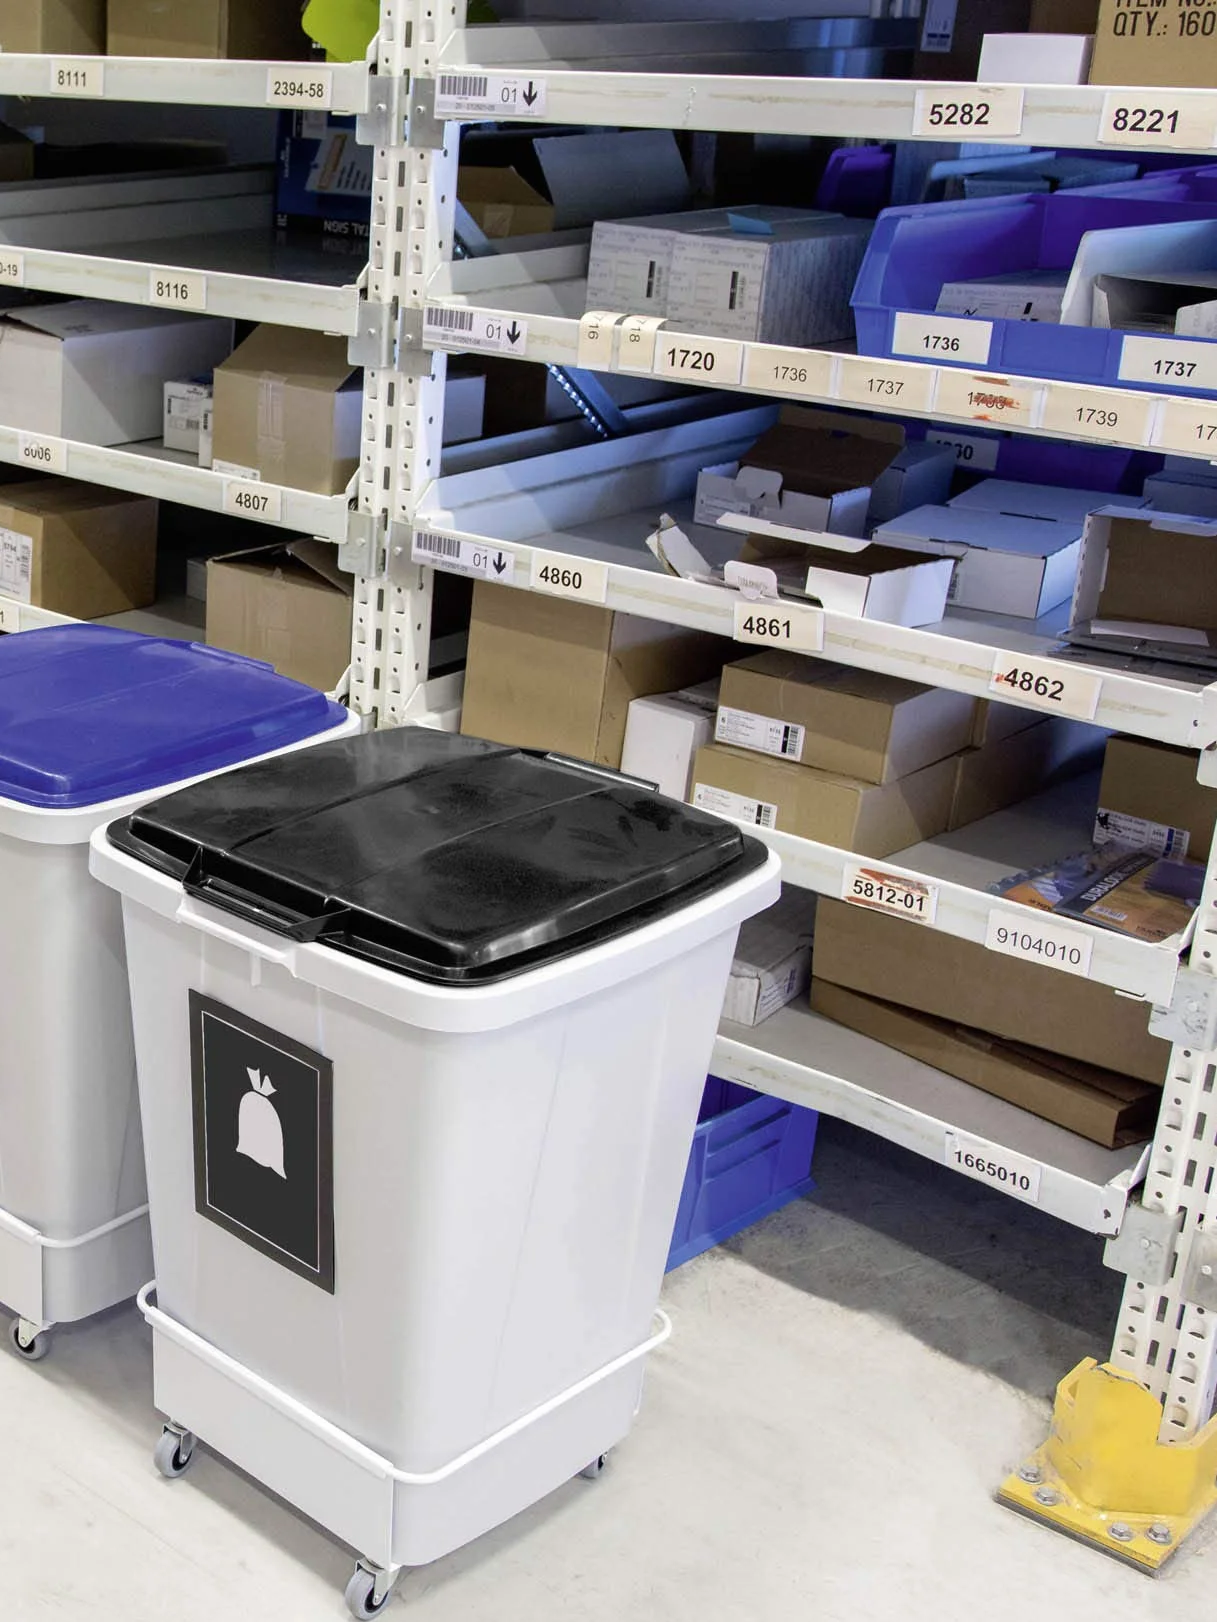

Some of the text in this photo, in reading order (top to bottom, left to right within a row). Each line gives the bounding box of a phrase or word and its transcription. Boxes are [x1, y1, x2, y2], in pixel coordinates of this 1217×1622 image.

[1113, 11, 1168, 36] QTY.:
[58, 69, 87, 87] 8111
[274, 80, 324, 99] 2394-58
[501, 87, 517, 103] 01
[929, 103, 990, 126] 5282
[1113, 108, 1179, 134] 8221
[156, 281, 188, 301] 8116
[486, 324, 502, 340] 01
[923, 335, 960, 352] 1736
[667, 347, 715, 371] 1720
[1153, 359, 1197, 378] 1737
[773, 365, 808, 383] 1736
[867, 378, 905, 396] 1737
[1075, 407, 1118, 428] 1739
[235, 493, 268, 513] 4807
[473, 552, 488, 569] 01
[539, 565, 583, 589] 4860
[742, 615, 793, 640] 4861
[1003, 667, 1066, 702] 4862
[852, 878, 926, 913] 5812-01
[996, 926, 1082, 966] 9104010
[953, 1148, 1031, 1192] 1665010
